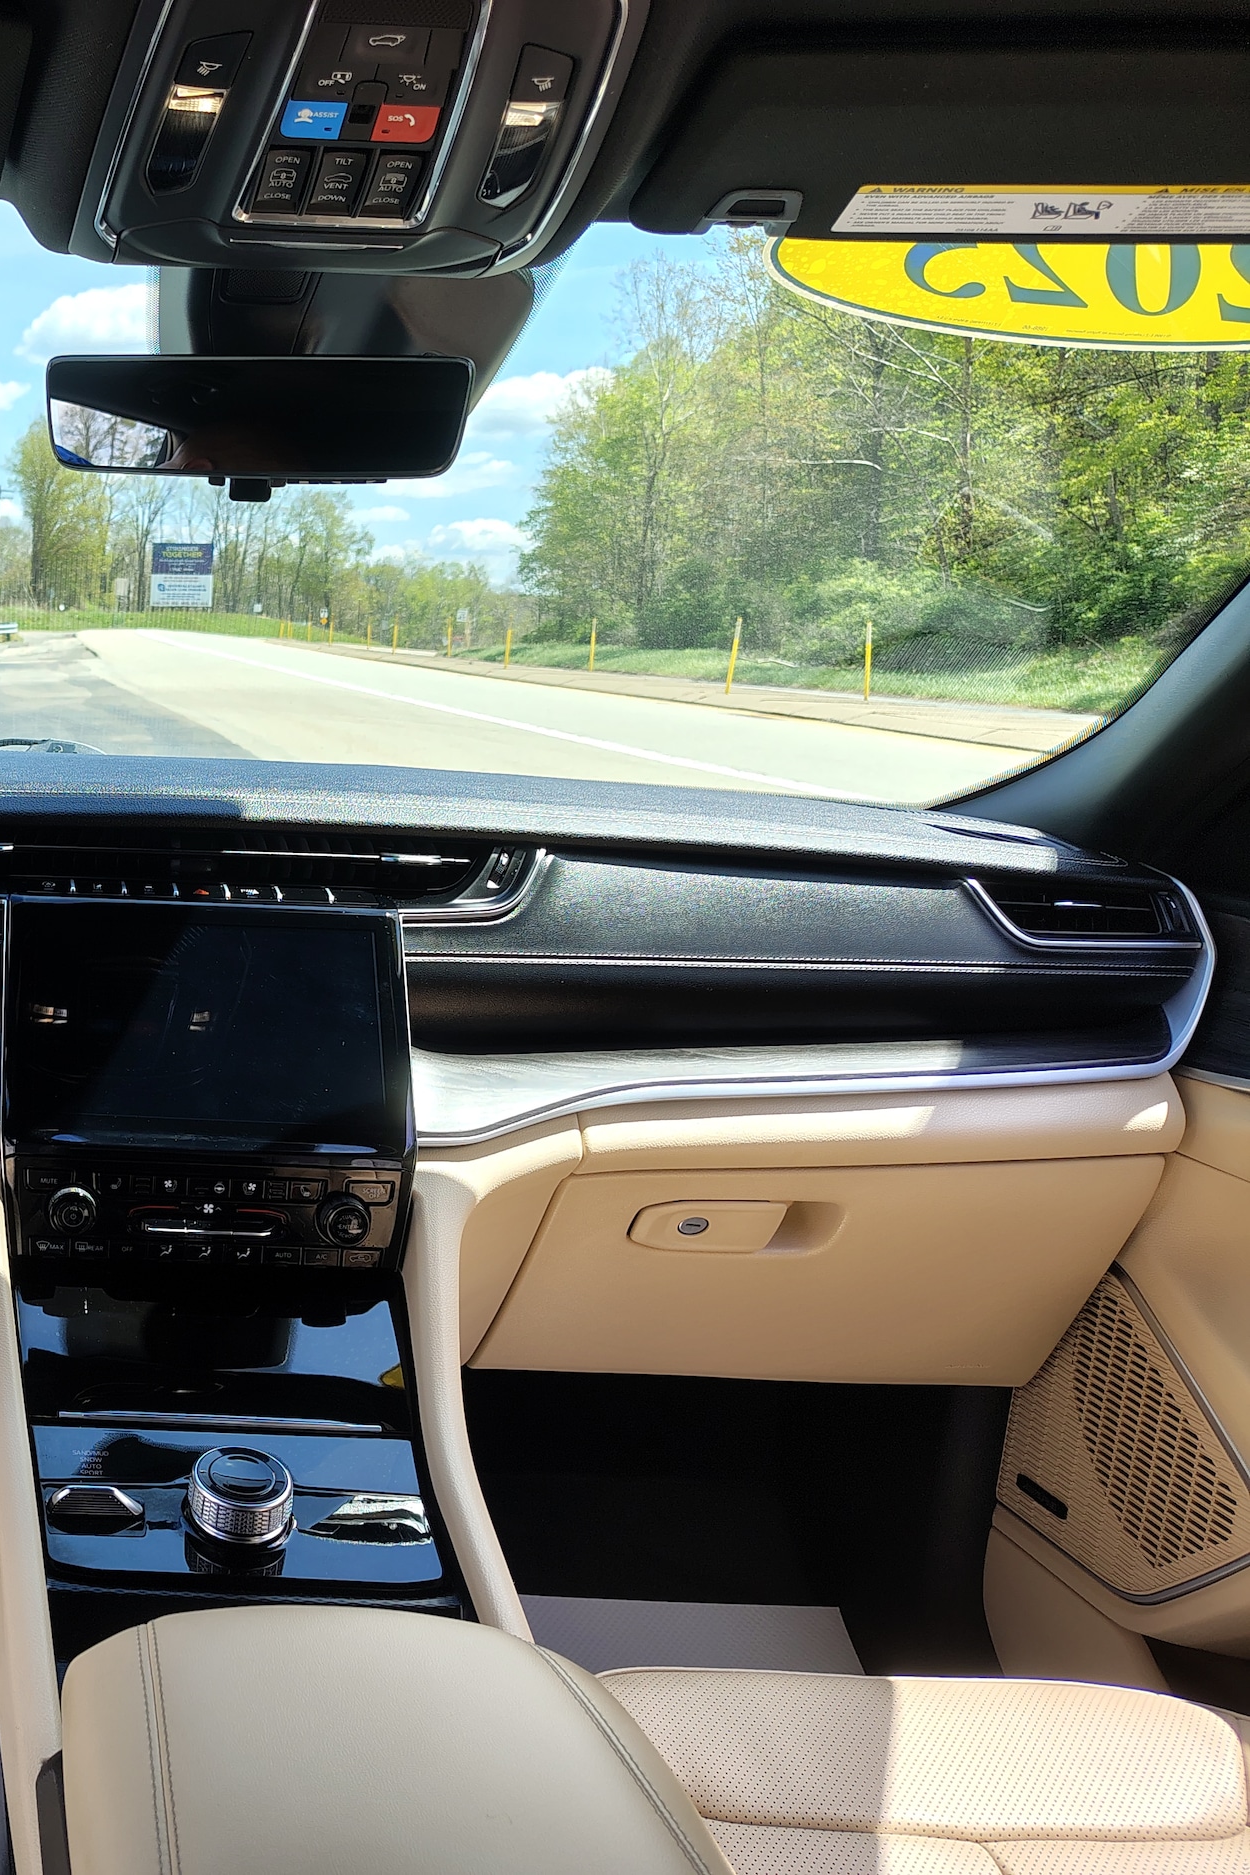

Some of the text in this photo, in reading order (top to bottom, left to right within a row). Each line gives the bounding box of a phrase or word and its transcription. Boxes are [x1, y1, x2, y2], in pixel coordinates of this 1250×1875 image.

[318, 79, 335, 87] OFF
[413, 82, 427, 91] ON
[313, 111, 339, 119] ASSIST
[388, 114, 404, 122] SOS
[274, 155, 301, 165] OPEN
[334, 157, 354, 166] TILT
[386, 160, 413, 170] OPEN
[268, 179, 295, 189] AUTO
[323, 182, 350, 191] VENT
[377, 184, 405, 194] AUTO
[263, 192, 292, 201] CLOSE
[317, 193, 347, 204] DOWN
[372, 196, 400, 206] CLOSE
[40, 1177, 58, 1185] MUTE
[315, 1253, 328, 1261] A/C
[72, 1449, 110, 1457] SAND/MUD
